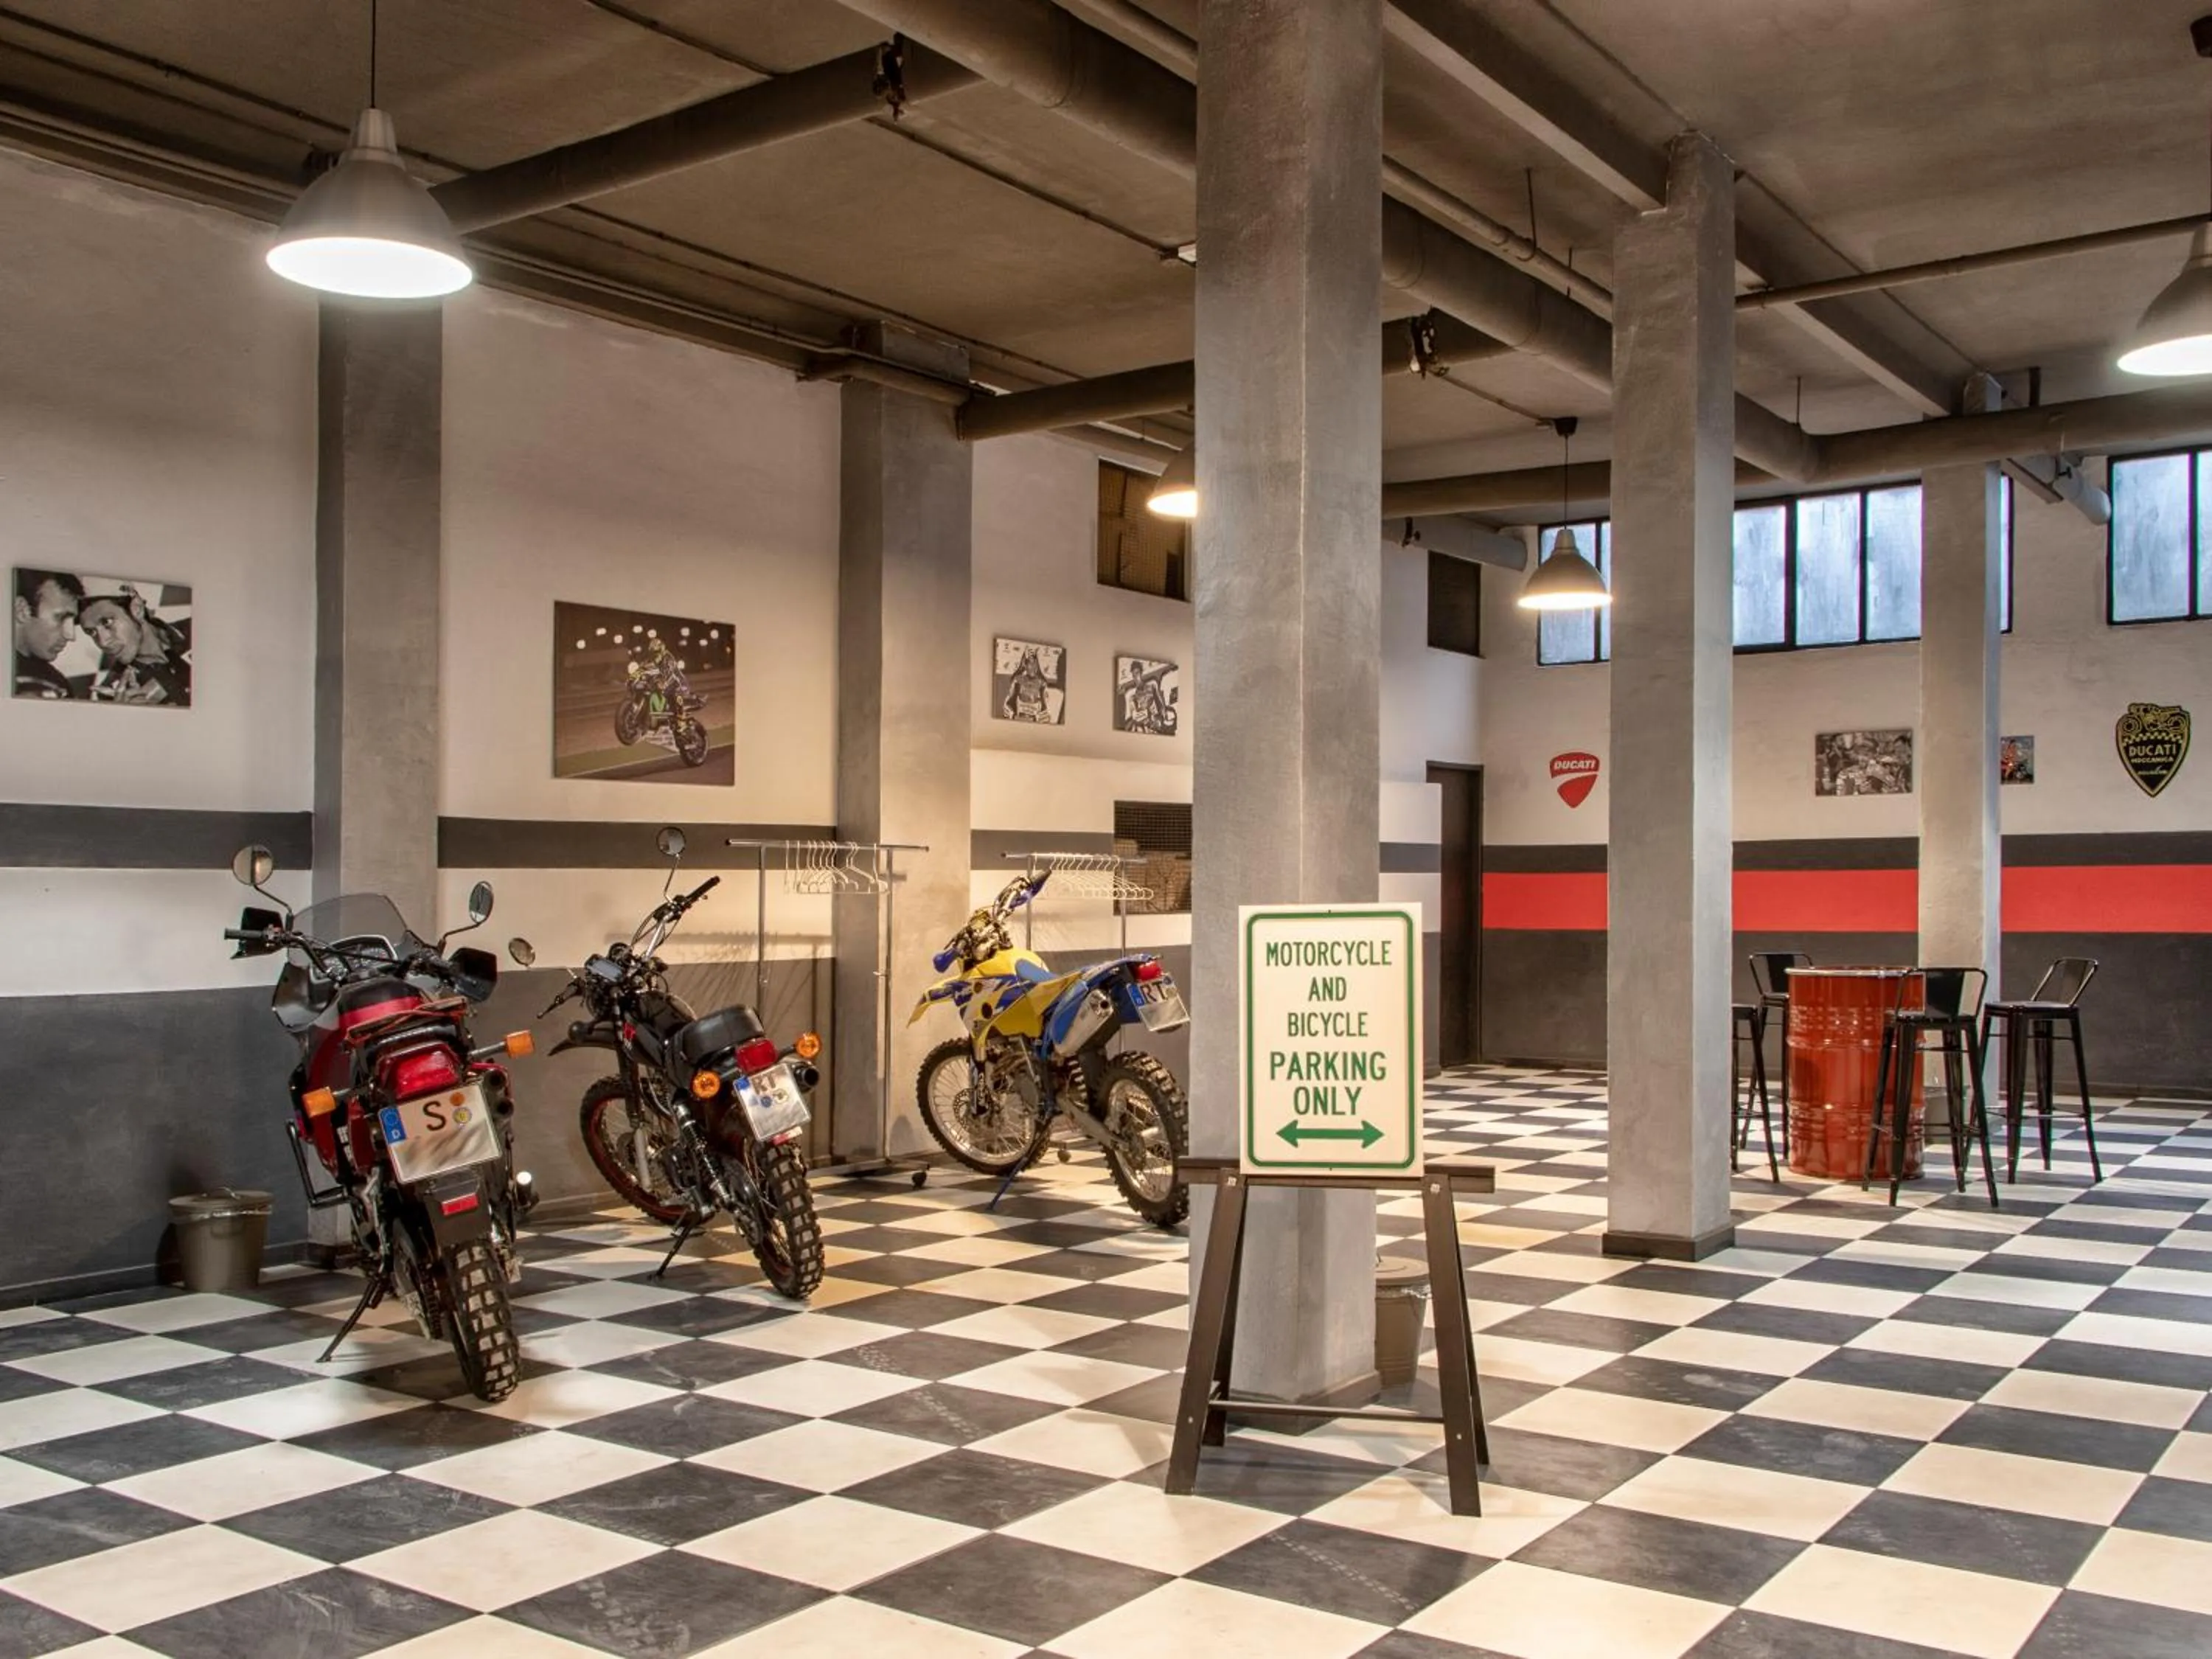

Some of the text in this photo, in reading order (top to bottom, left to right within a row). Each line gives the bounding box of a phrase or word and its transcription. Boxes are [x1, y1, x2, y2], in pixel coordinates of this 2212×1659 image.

[2128, 744, 2177, 757] DUCATI
[1554, 759, 1596, 770] DUCATI
[1265, 940, 1392, 967] MOTORCYCLE
[1140, 980, 1168, 1004] RT
[1307, 977, 1347, 1002] AND
[1287, 1012, 1368, 1037] BICYCLE
[1270, 1051, 1387, 1081] PARKING
[1293, 1086, 1362, 1116] ONLY
[422, 1101, 446, 1132] S
